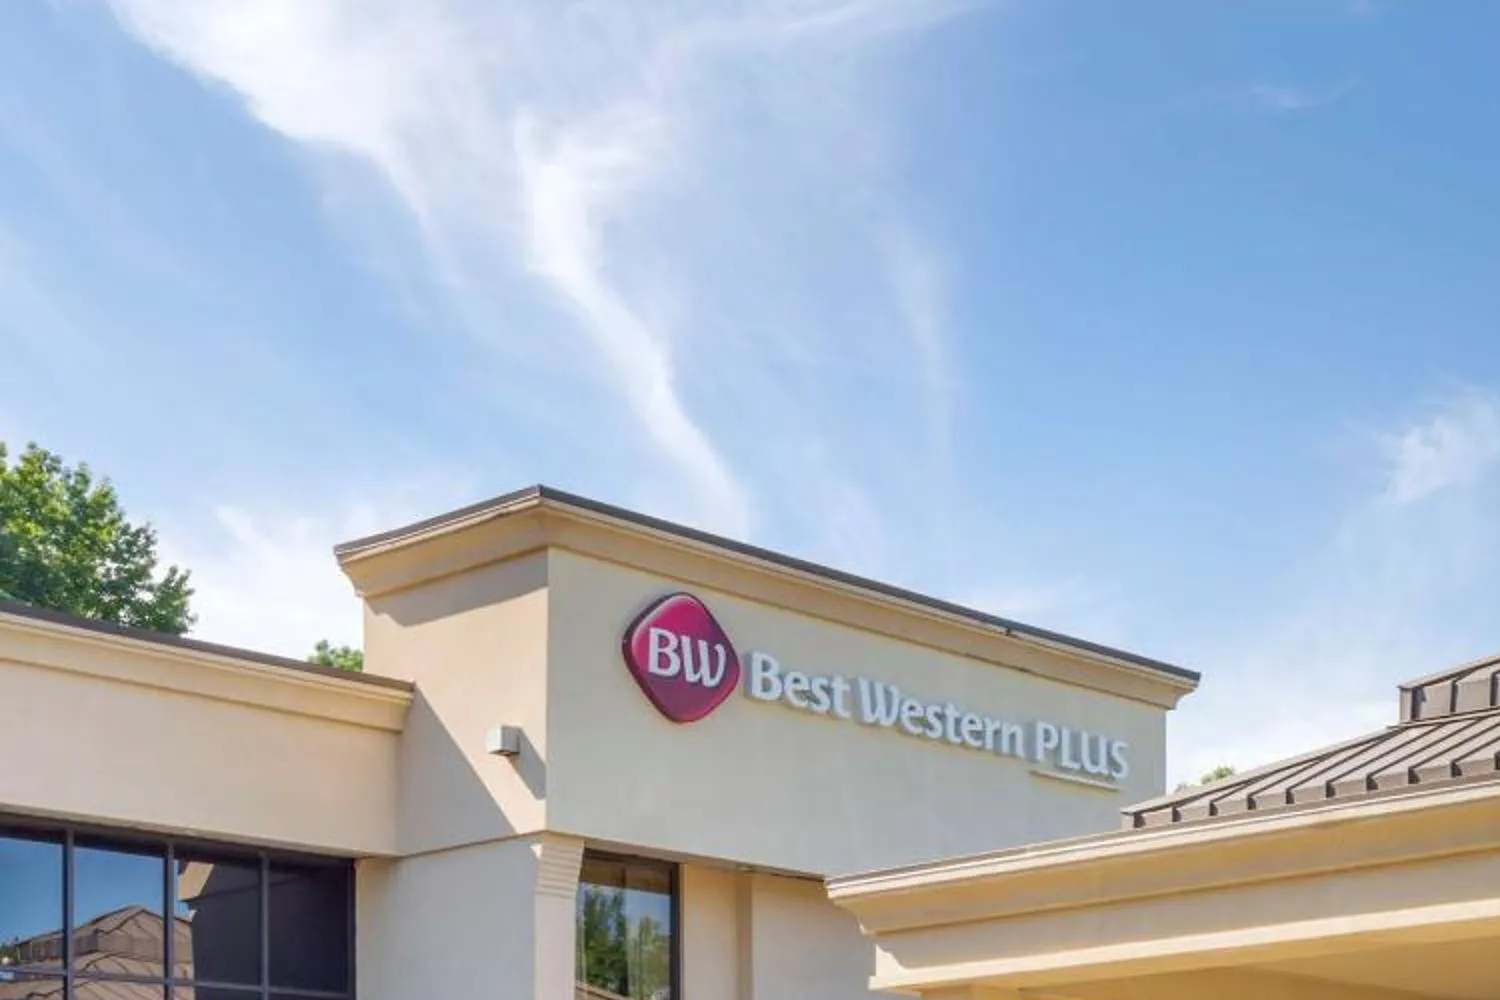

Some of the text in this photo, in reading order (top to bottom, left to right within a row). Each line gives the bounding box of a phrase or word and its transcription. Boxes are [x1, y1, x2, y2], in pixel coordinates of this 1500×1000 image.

[648, 627, 727, 688] BW
[749, 650, 1130, 780] Best Western PLUS
